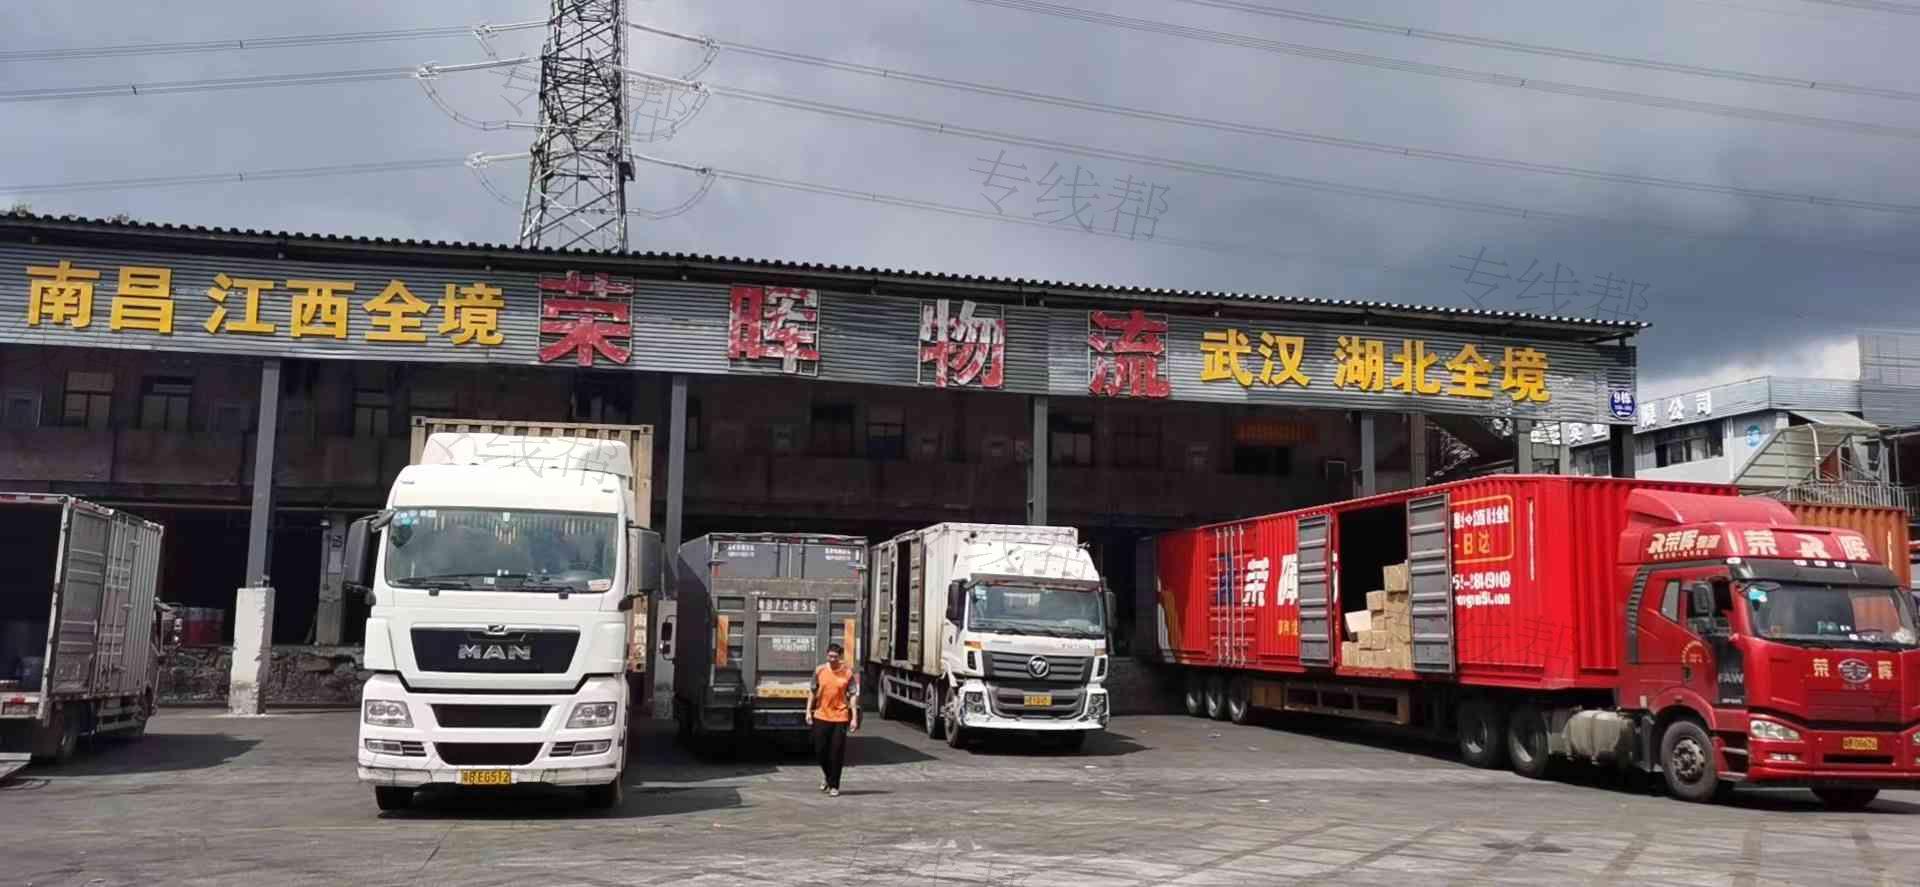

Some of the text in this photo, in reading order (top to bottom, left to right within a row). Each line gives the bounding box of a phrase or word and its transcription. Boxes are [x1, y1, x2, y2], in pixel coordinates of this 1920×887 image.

[27, 260, 505, 346] 南昌 江西全境
[538, 271, 1170, 399] 荣晖物流
[1200, 328, 1551, 402] 武汉 湖北全境
[457, 645, 531, 660] MAN
[1717, 672, 1744, 683] FAW
